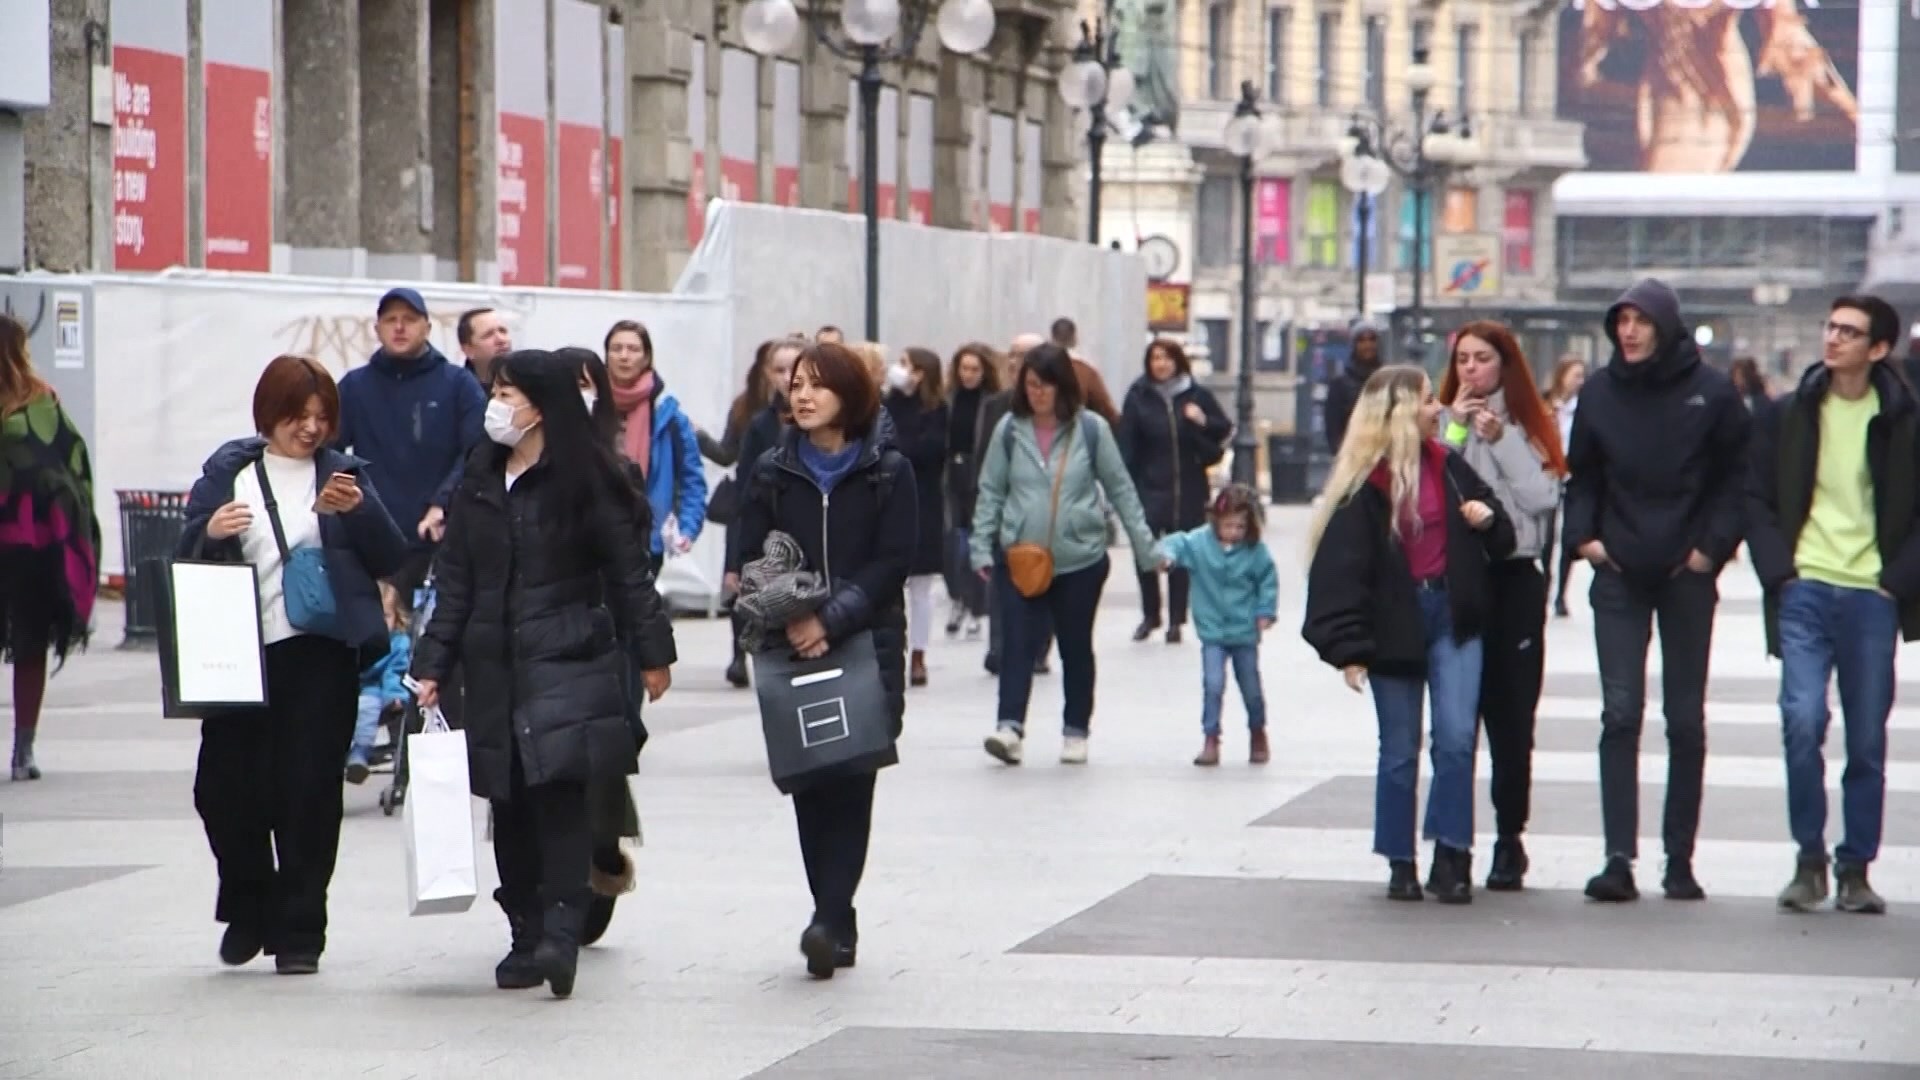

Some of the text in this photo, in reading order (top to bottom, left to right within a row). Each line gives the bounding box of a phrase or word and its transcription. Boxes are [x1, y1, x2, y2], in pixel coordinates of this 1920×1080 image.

[114, 72, 150, 115] We are
[114, 115, 156, 168] building
[115, 170, 147, 202] a new
